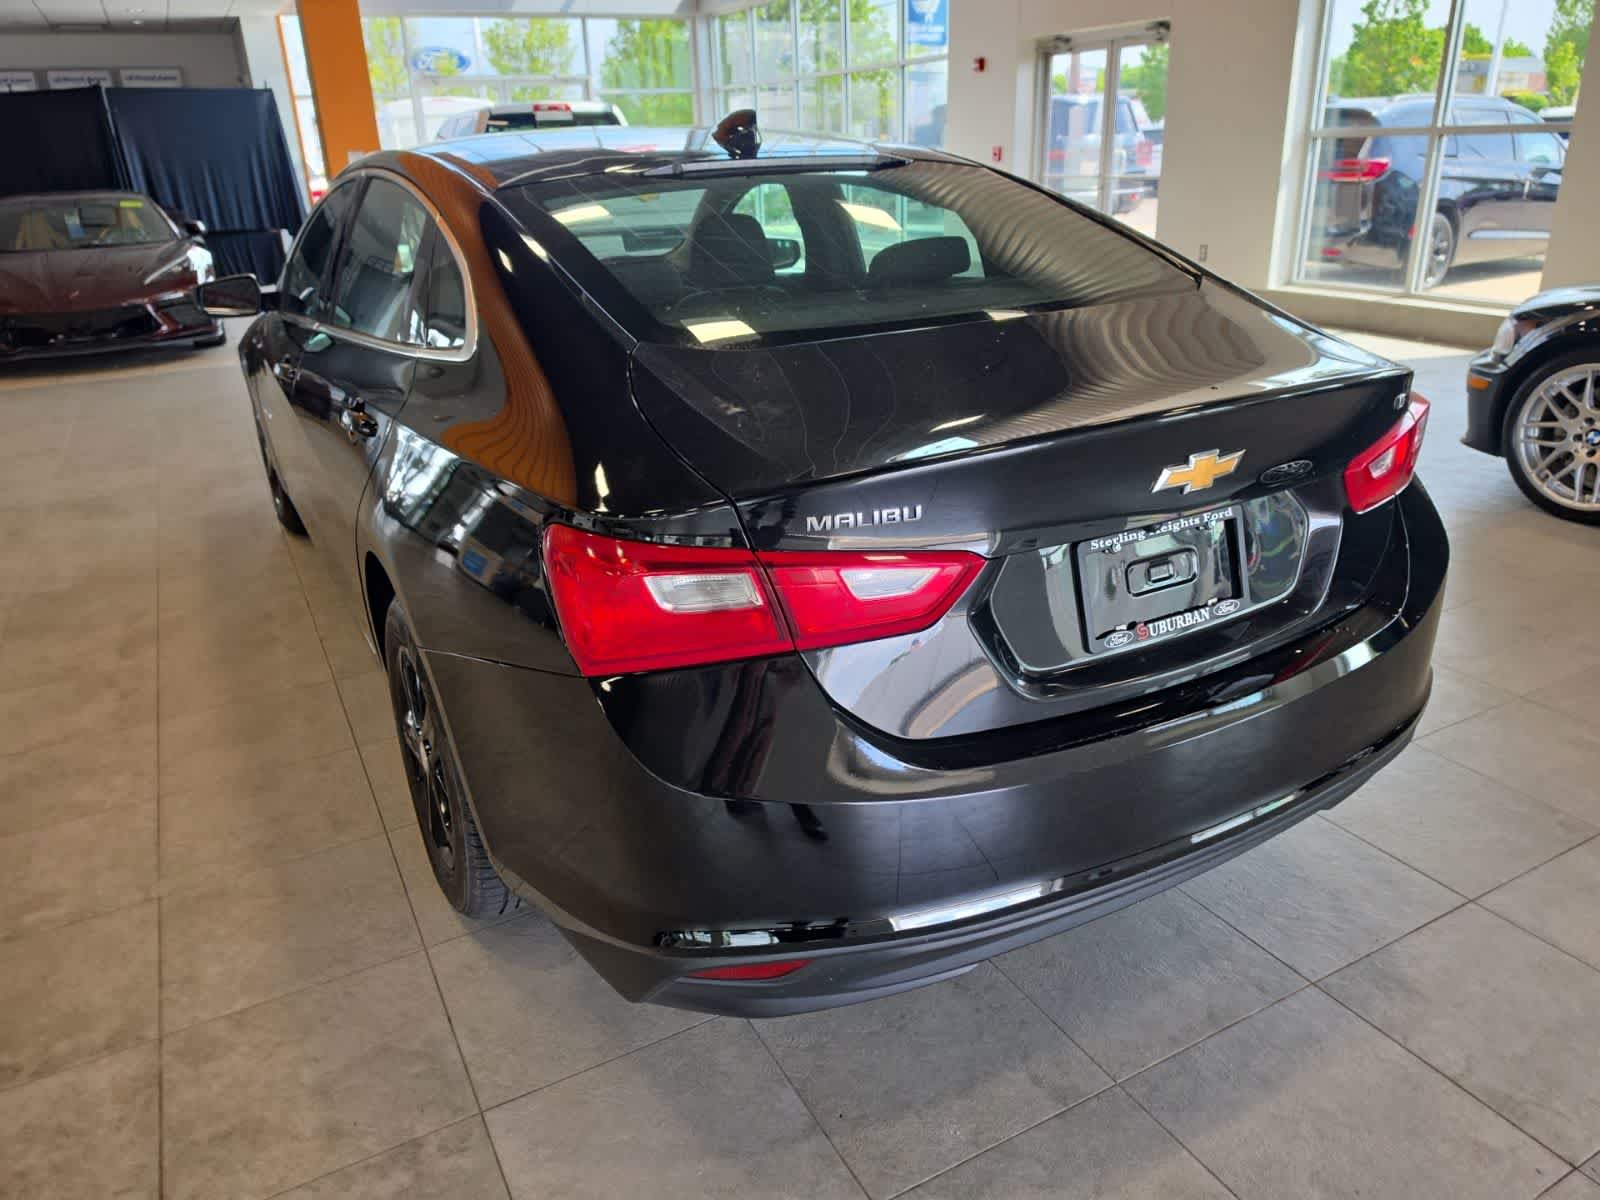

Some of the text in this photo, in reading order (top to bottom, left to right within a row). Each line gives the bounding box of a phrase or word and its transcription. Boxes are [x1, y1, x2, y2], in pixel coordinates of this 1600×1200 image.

[806, 504, 922, 532] MALIBU
[1090, 528, 1147, 551] Sterling
[1202, 506, 1233, 522] Ford
[1136, 606, 1210, 641] SUBURBAN
